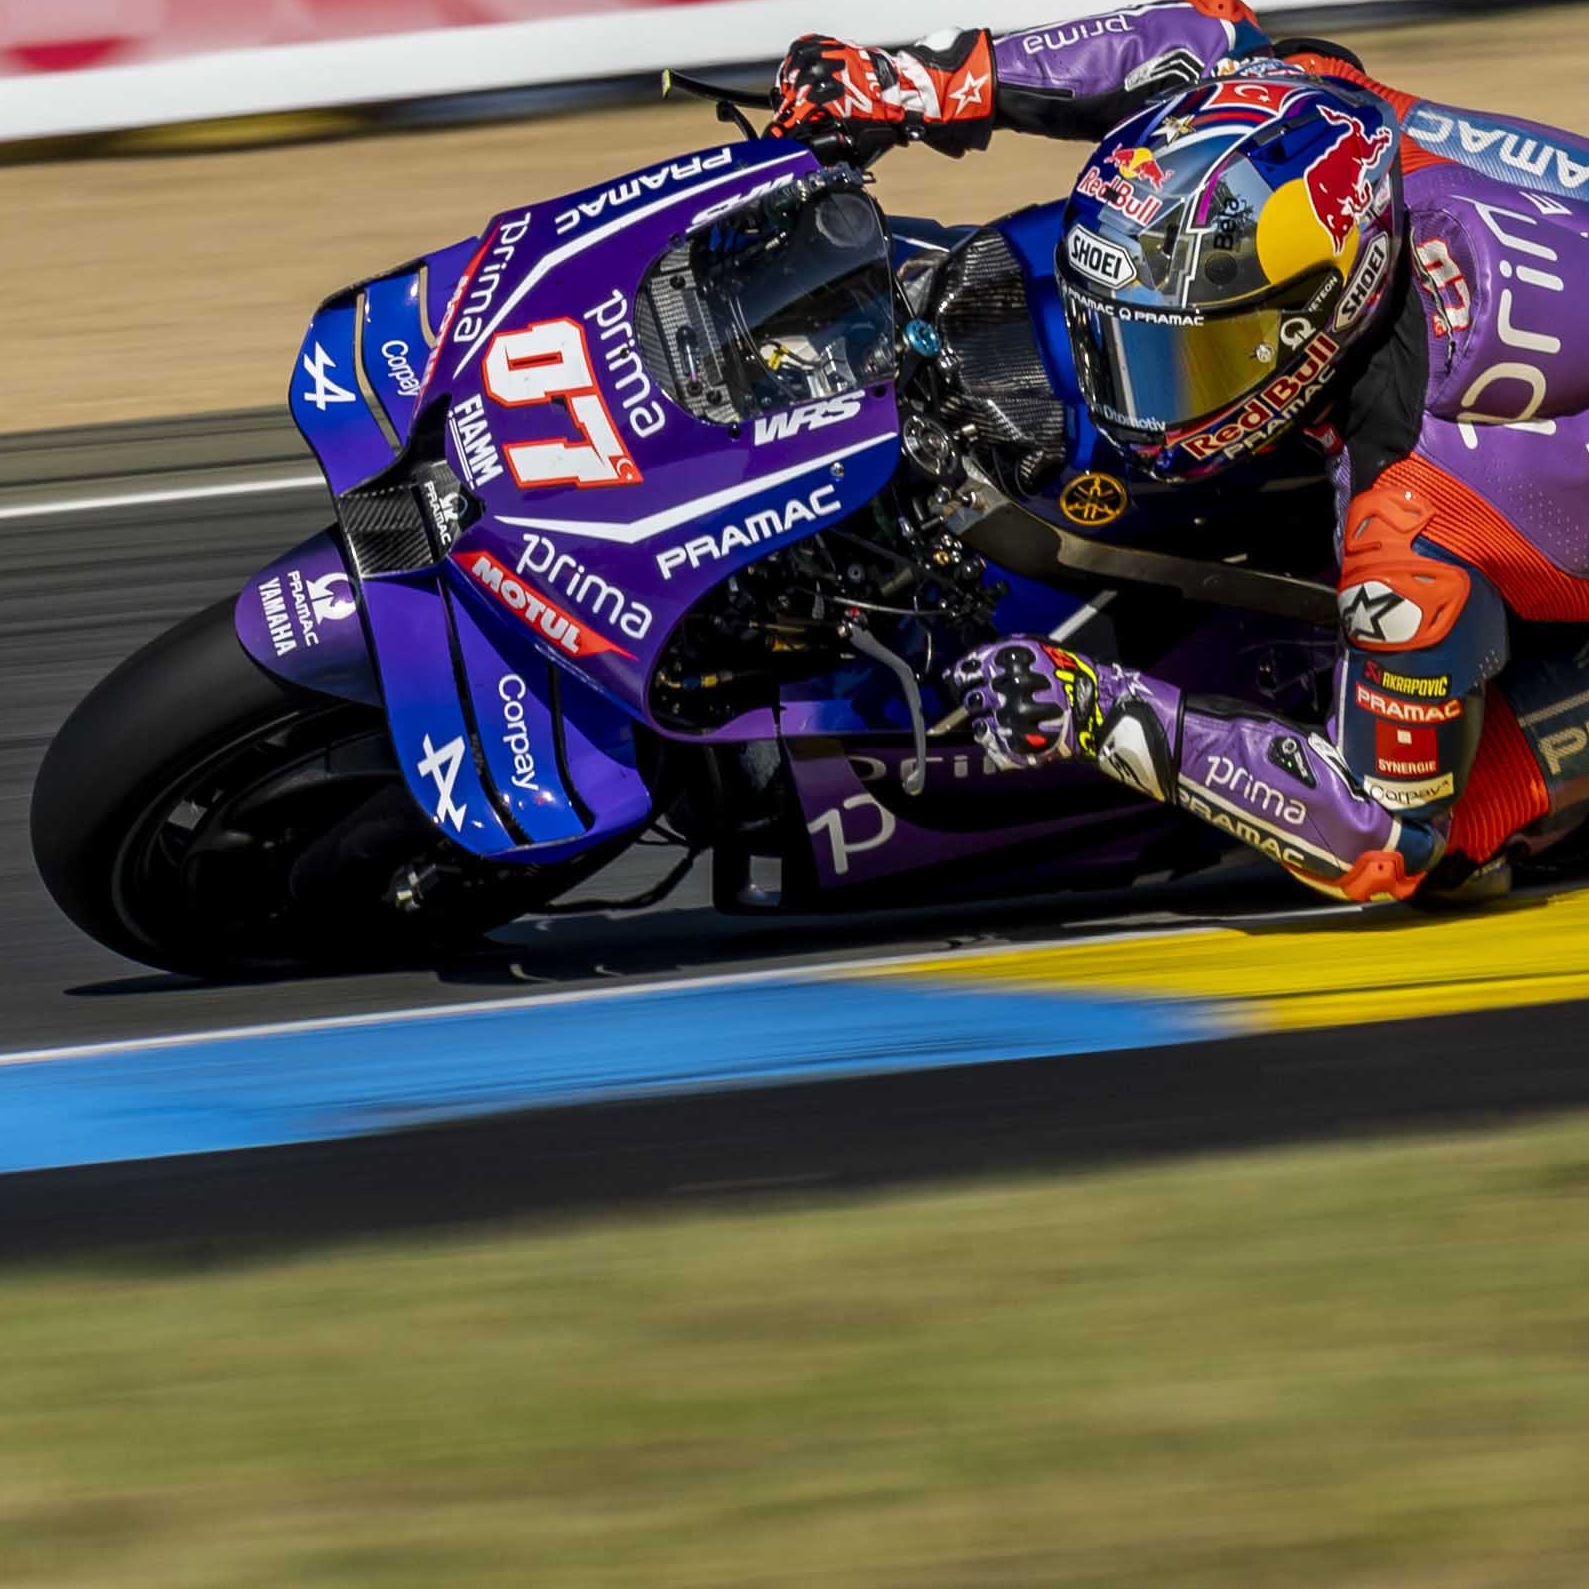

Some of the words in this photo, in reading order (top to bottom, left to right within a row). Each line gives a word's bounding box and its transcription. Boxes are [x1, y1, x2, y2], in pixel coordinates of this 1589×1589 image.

[1024, 13, 1133, 56] prima
[554, 147, 732, 235] PRAMAC
[453, 212, 531, 344] prima
[1069, 236, 1123, 280] SHOEI
[1342, 244, 1385, 321] SHOEI
[1135, 310, 1205, 327] PRAMAC
[381, 339, 421, 398] Corpay
[583, 289, 666, 439] prima
[1180, 398, 1274, 460] Red
[1260, 331, 1341, 411] Bull
[453, 393, 504, 487] FIAMM
[754, 390, 865, 446] WRS
[1223, 366, 1337, 461] PRAMAC
[424, 481, 452, 545] PRAMAC
[655, 483, 842, 581] PRAMAC
[258, 577, 298, 657] YAMAHA
[287, 570, 319, 646] PRAMAC
[471, 556, 581, 654] MOTUL
[516, 533, 653, 640] prima
[498, 673, 539, 792] Corpay
[1356, 685, 1462, 722] PRAMAC
[1205, 755, 1308, 825] prima
[1378, 759, 1437, 775] SYNERGIE
